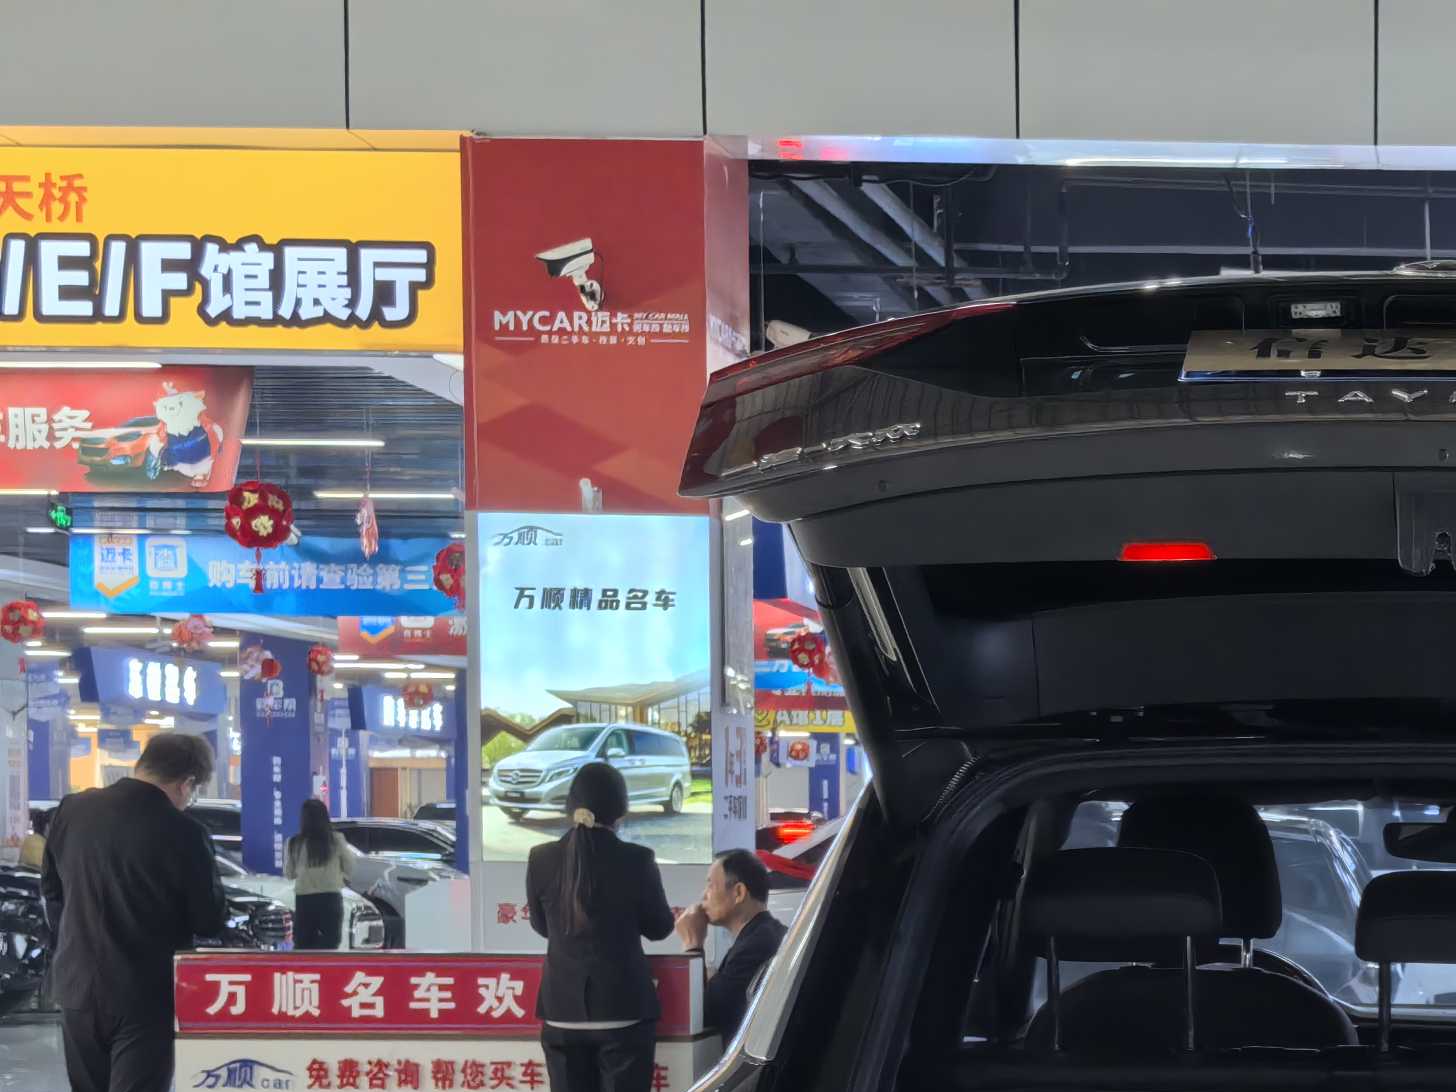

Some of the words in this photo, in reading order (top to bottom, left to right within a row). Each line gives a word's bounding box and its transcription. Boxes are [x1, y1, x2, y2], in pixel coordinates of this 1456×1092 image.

[0, 172, 88, 224] 天桥
[0, 405, 94, 451] 服务
[513, 586, 677, 611] 万顺精品名车
[204, 972, 526, 1018] 万顺名车欢
[306, 1058, 420, 1090] 免费咨询
